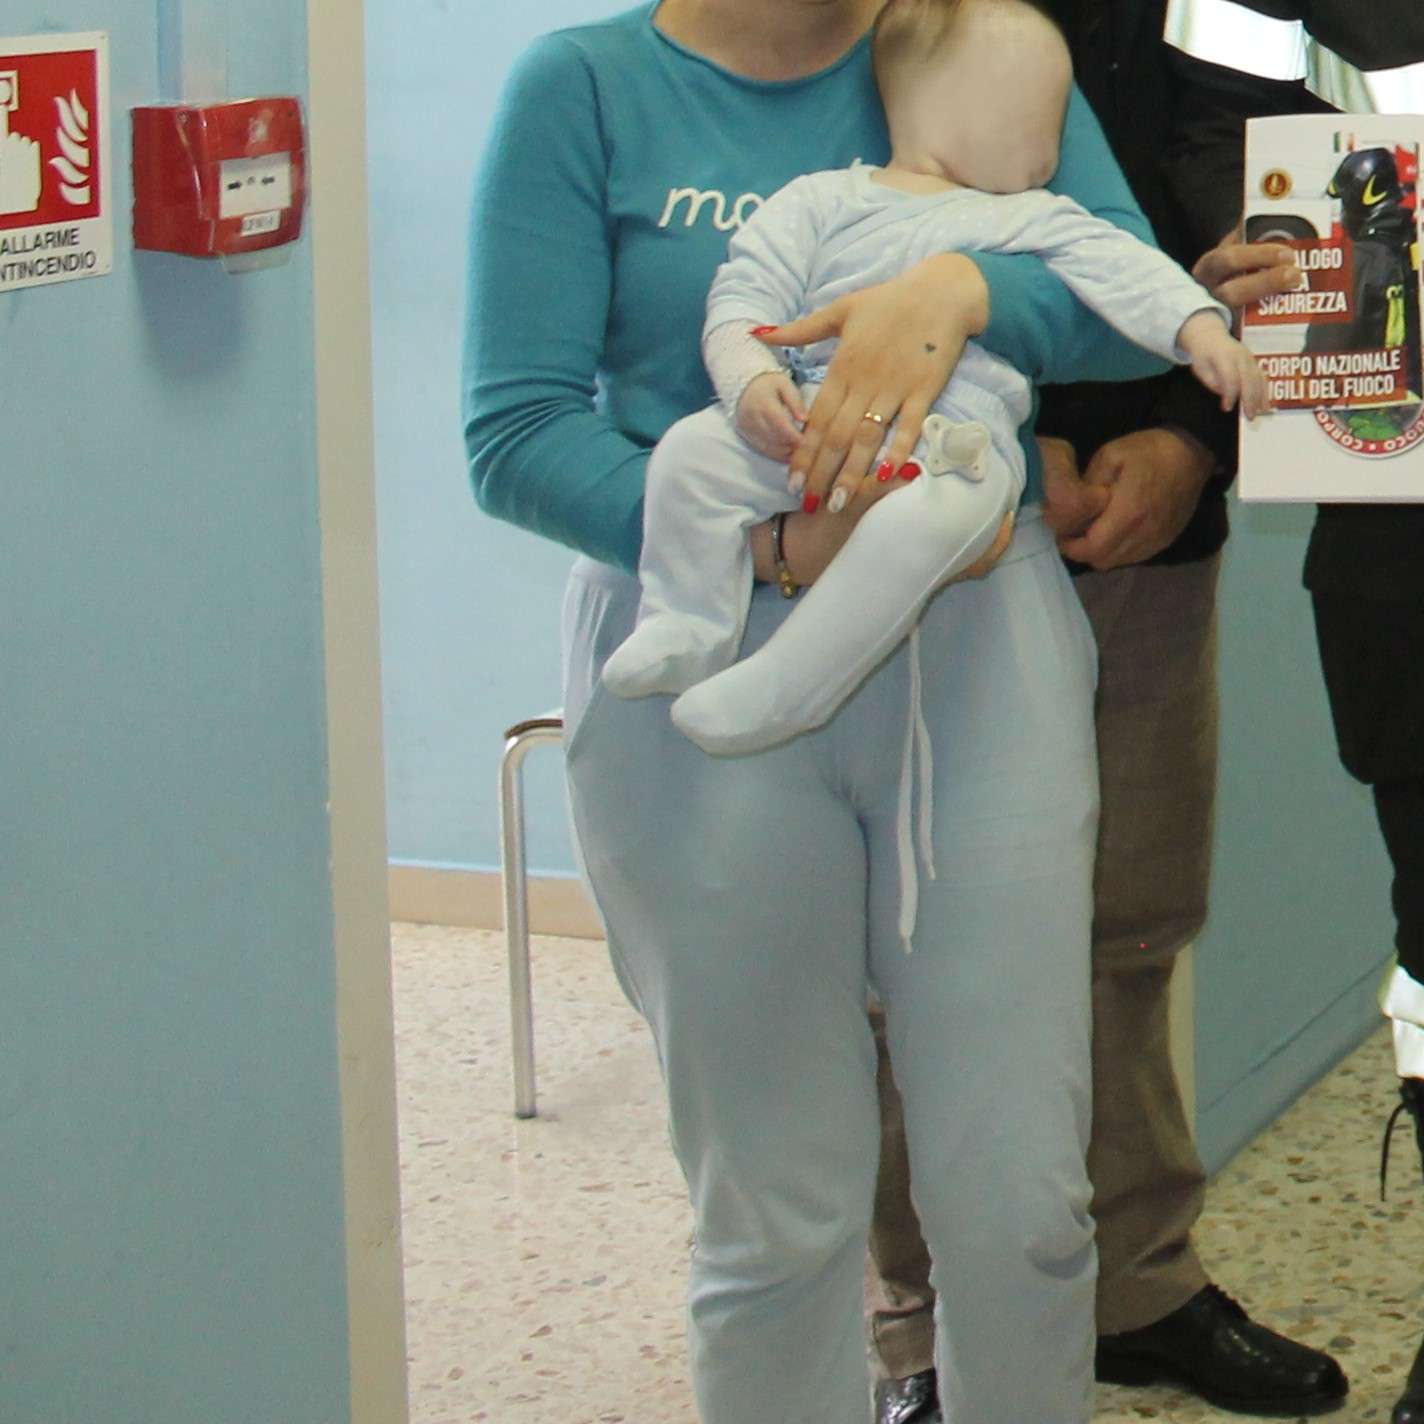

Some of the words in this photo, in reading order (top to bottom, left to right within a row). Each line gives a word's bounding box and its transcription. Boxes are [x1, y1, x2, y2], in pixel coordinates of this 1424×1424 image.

[0, 227, 80, 255] ALLARME
[0, 250, 97, 282] NTINCENDIO
[1257, 291, 1348, 316] SICUREZZA
[1258, 355, 1312, 378] CORPO
[1316, 349, 1401, 375] NAZIONALE
[1269, 380, 1304, 400] IGILI
[1309, 378, 1340, 400] DEL
[1343, 374, 1395, 398] FUOCO
